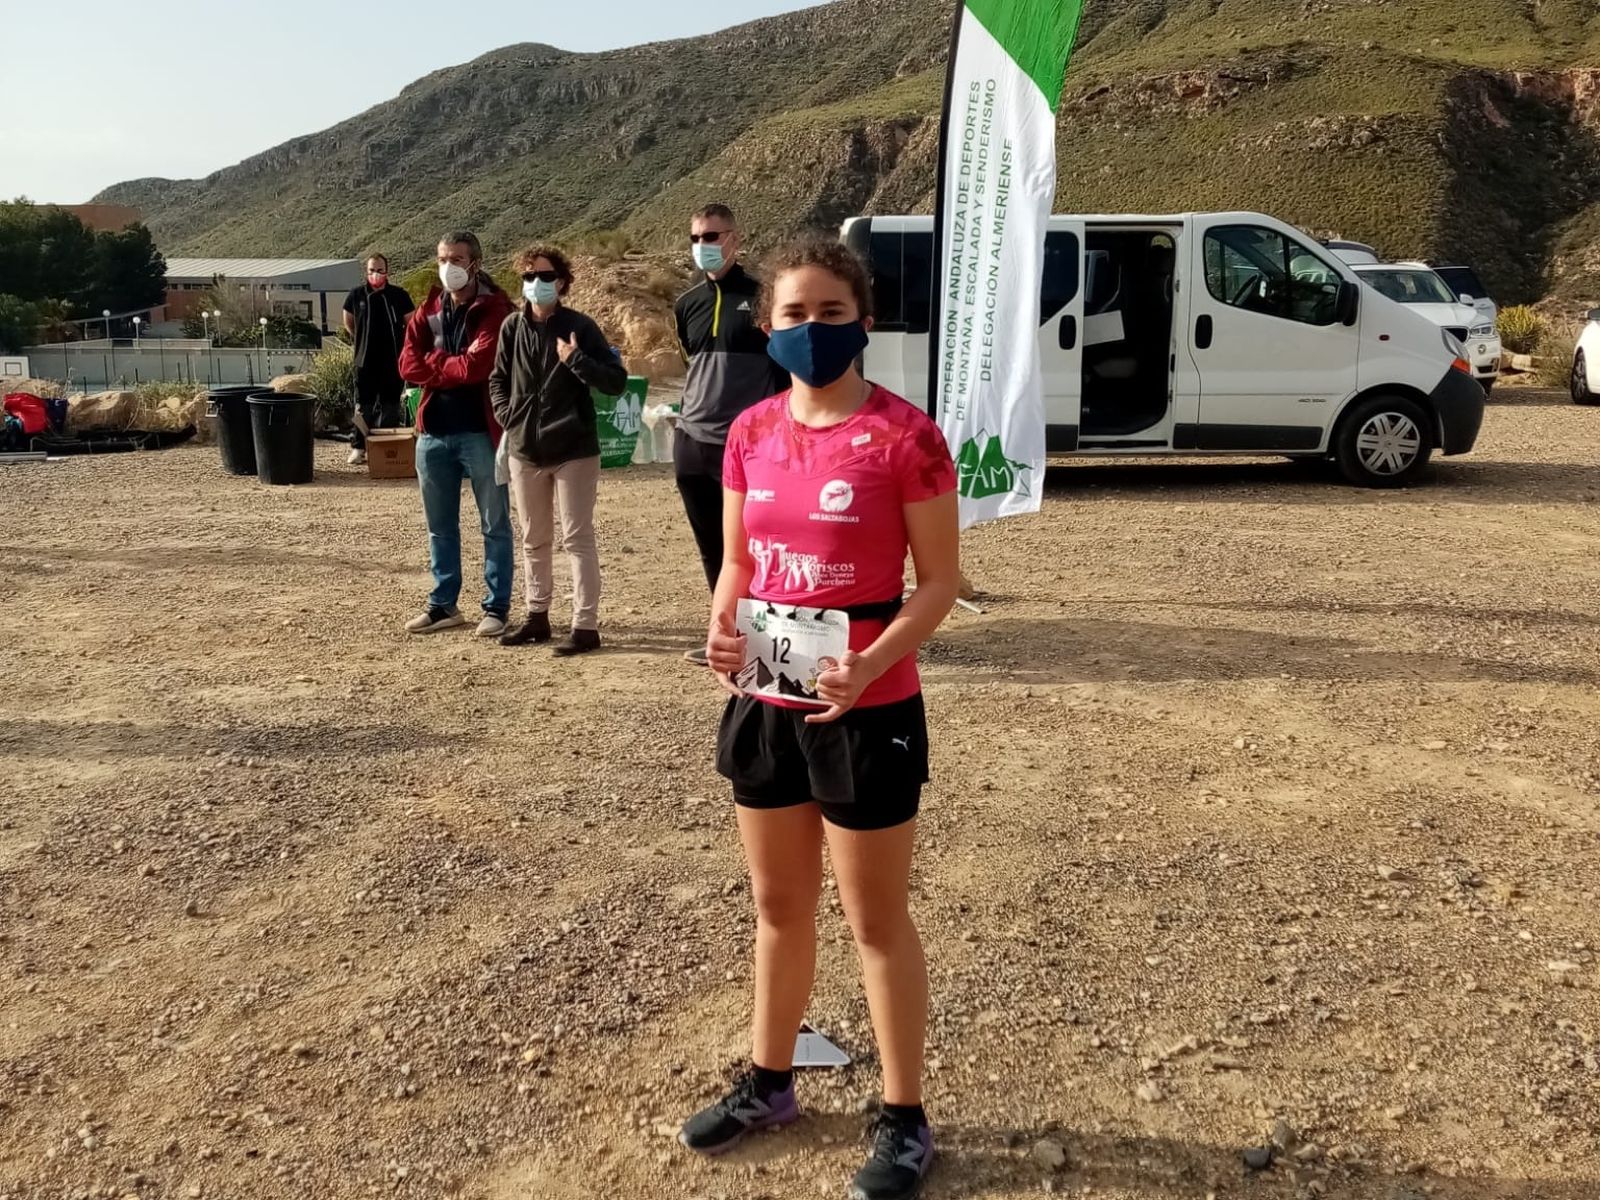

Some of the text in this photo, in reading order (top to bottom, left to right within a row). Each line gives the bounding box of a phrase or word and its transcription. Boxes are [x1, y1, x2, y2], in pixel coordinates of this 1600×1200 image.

[960, 80, 980, 177] DEPORTES
[975, 78, 997, 195] SENDERISMO
[957, 180, 970, 204] DE
[973, 199, 984, 212] Y
[990, 138, 1013, 261] ALMERIENSE
[949, 209, 967, 301] ANDALUZA
[965, 215, 983, 306] ESCALADA
[956, 399, 966, 421] DE
[771, 542, 819, 576] Juegos
[784, 557, 856, 593] Moriscos
[771, 636, 791, 664] 12
